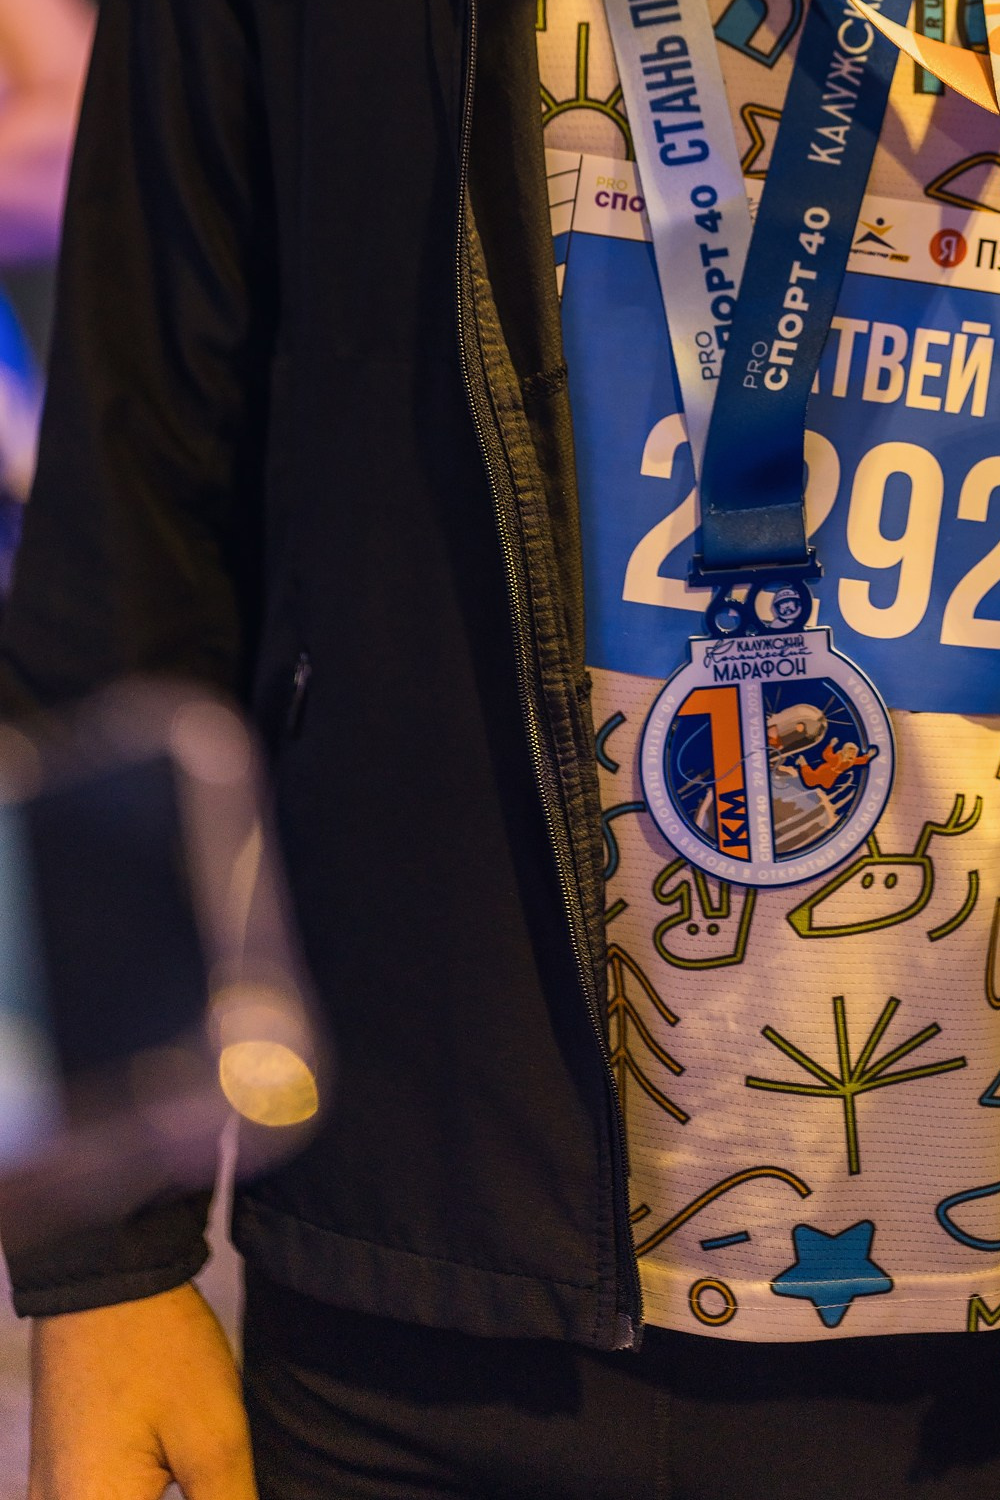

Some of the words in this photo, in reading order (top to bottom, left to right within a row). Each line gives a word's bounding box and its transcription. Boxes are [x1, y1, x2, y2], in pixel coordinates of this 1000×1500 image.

[641, 36, 710, 167] СТАНЬ
[594, 190, 646, 213] СПО
[596, 175, 629, 191] PRO
[690, 184, 723, 234] 40
[701, 243, 736, 353] ПОРТ
[763, 261, 818, 392] СПОРТ
[798, 206, 831, 256] 40
[694, 330, 720, 381] PRO
[743, 340, 768, 390] PRO
[812, 317, 996, 418] ТВЕЙ
[713, 657, 807, 682] МАРАФОН
[720, 789, 749, 848] КМ
